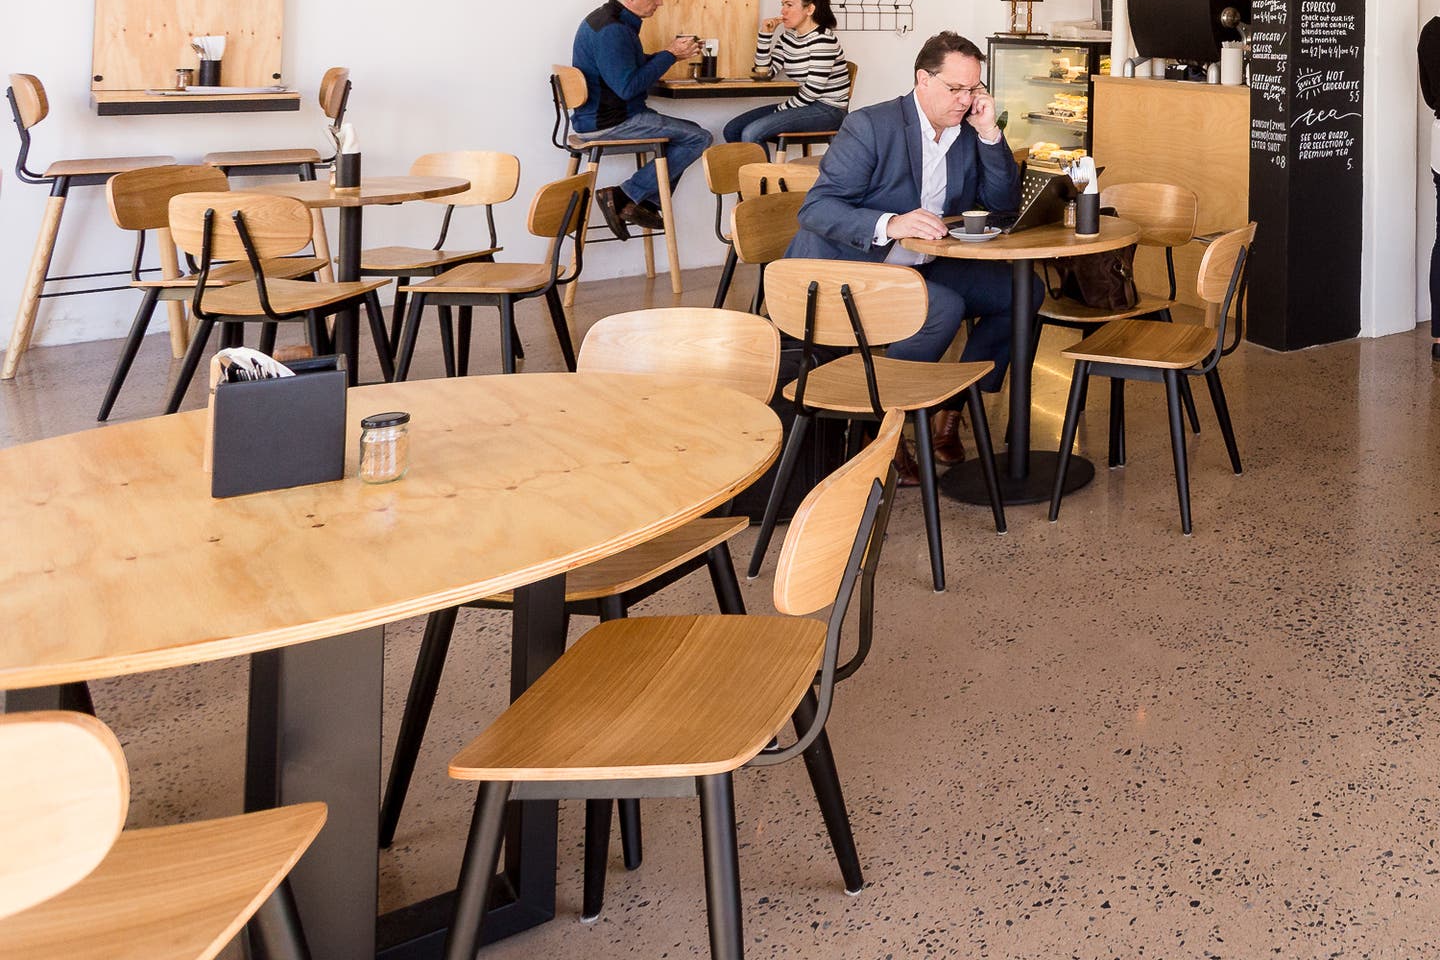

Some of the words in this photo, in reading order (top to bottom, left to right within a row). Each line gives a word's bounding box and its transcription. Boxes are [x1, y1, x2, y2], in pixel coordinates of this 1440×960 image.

[1301, 1, 1336, 13] ESPRESSO
[1319, 14, 1330, 22] out
[1314, 36, 1337, 44] month
[1326, 70, 1345, 81] HOT
[1322, 80, 1360, 91] CHOCOLATE
[1290, 108, 1362, 128] tea
[1300, 132, 1311, 142] SEE
[1313, 132, 1327, 140] OUR
[1328, 131, 1349, 140] BOARD
[1299, 141, 1312, 150] FOR
[1312, 139, 1344, 150] SELECTION
[1345, 138, 1354, 146] OF
[1299, 150, 1333, 160] PREMIUM
[1335, 148, 1349, 156] TEA
